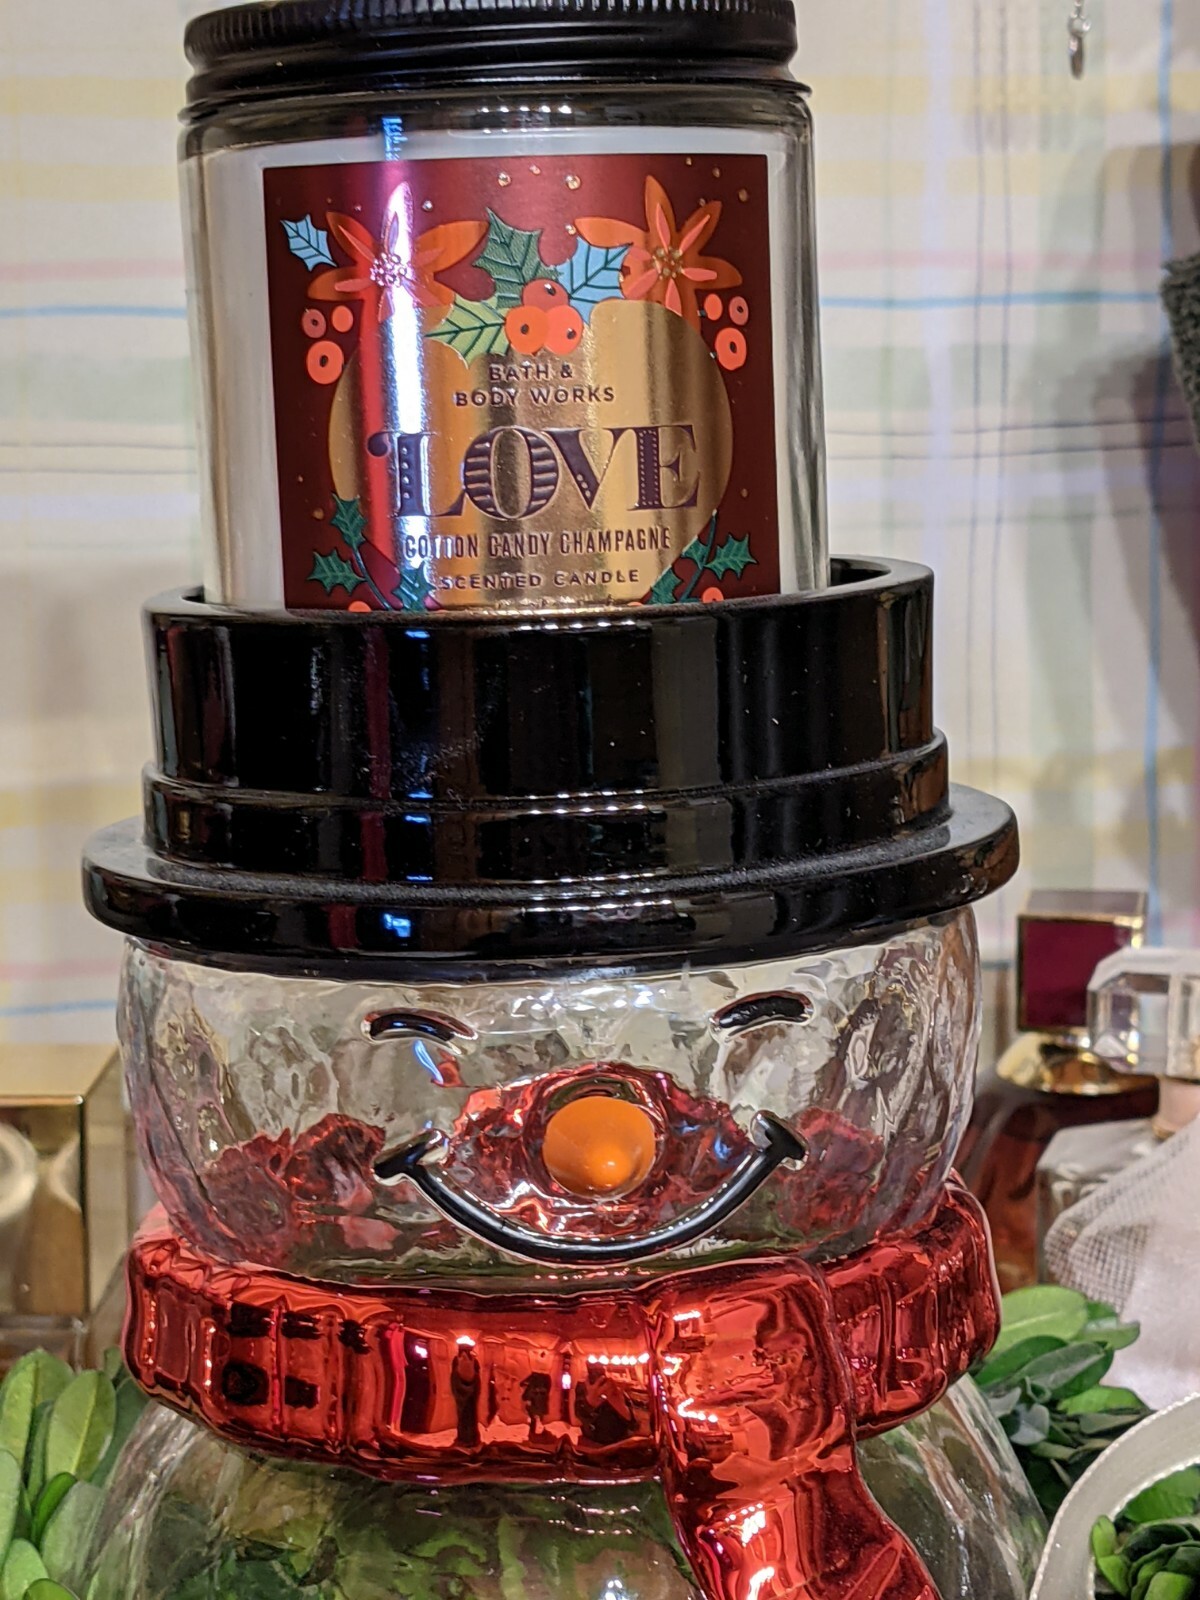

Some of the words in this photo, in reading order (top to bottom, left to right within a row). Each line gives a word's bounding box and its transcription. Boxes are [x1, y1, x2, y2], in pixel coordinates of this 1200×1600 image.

[489, 363, 549, 381] BATH
[561, 364, 574, 379] &
[455, 387, 520, 407] BODY
[531, 385, 615, 405] WORKS
[367, 424, 700, 521] LOVE
[404, 533, 479, 560] COTTON
[489, 531, 551, 557] CANDY
[560, 526, 671, 556] CHAMPAGNE
[440, 573, 542, 591] SCENTED
[554, 569, 640, 587] CANDLE
